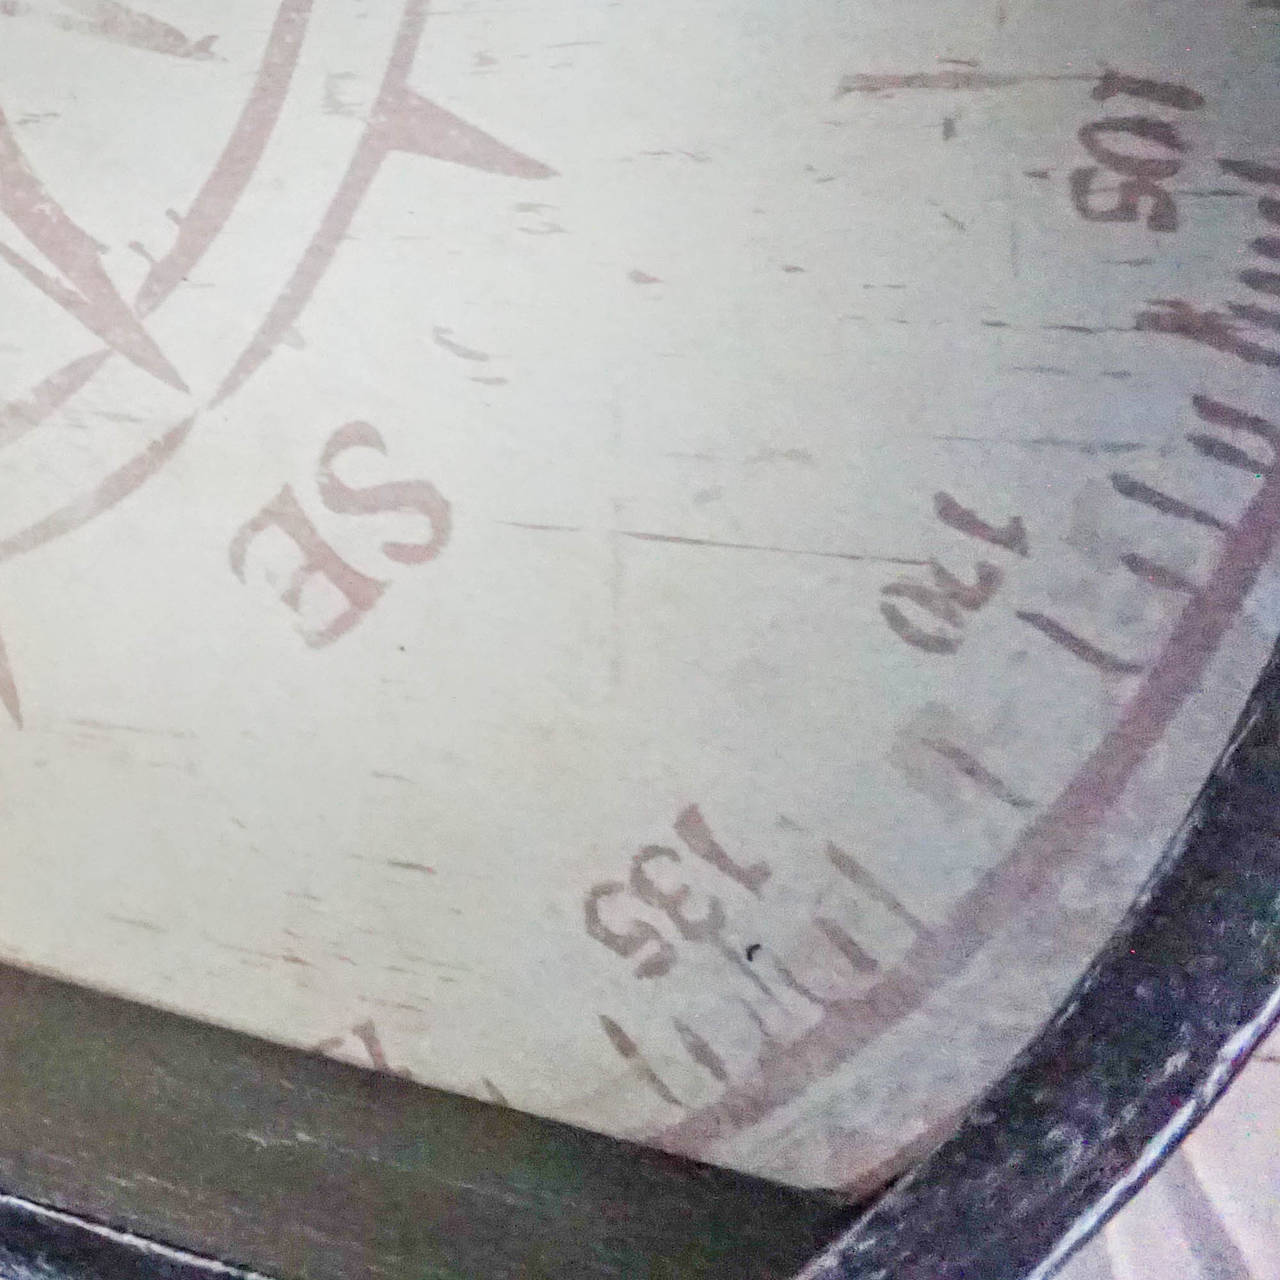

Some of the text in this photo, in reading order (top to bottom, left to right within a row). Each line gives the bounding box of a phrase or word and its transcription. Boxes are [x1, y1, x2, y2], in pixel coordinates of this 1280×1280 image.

[1070, 68, 1206, 232] 105
[227, 419, 453, 650] SE
[583, 802, 772, 980] 135
